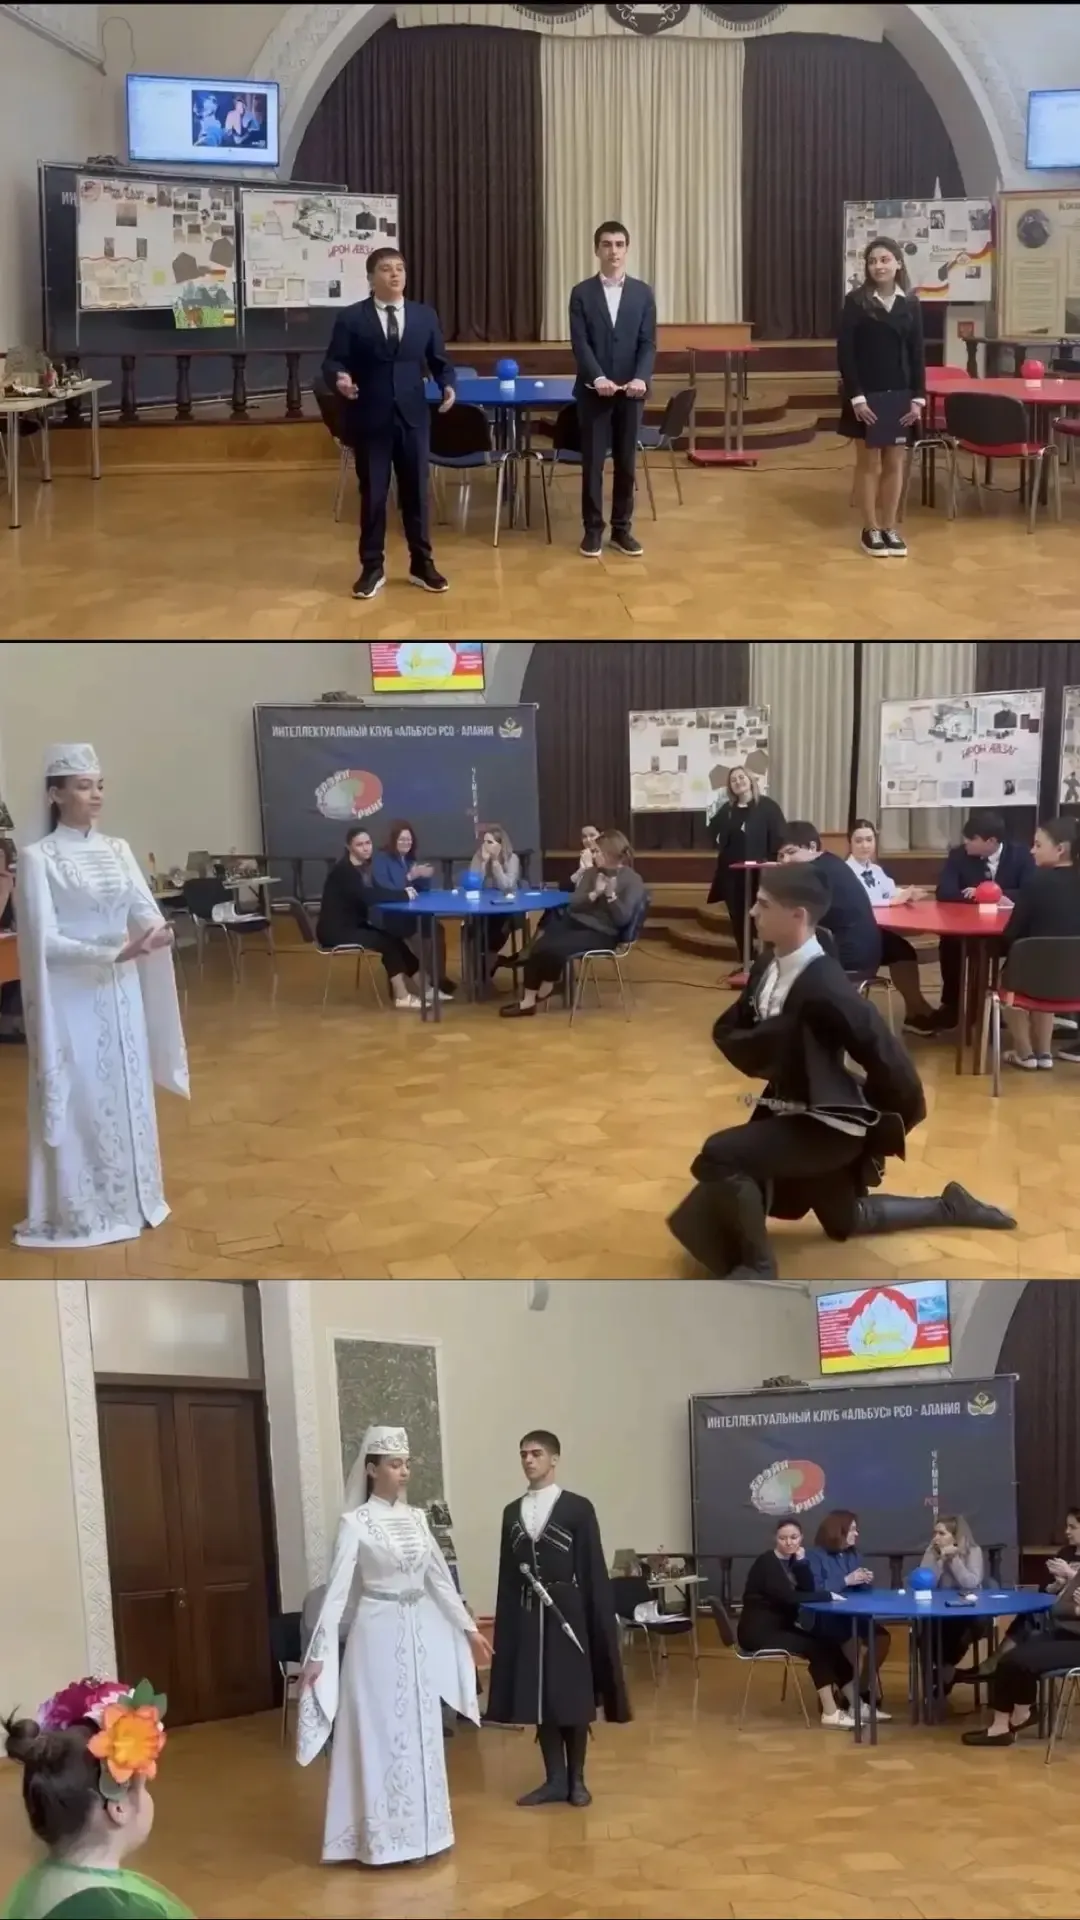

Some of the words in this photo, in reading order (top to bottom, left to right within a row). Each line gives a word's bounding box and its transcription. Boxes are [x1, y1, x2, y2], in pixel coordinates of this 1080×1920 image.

[272, 725, 368, 737] ИНТЕЛЛЕКТУАЛЬНЫЙ
[369, 725, 393, 737] КЛУБ
[438, 725, 455, 736] РСО
[461, 725, 494, 737] АЛАНИЯ
[707, 1409, 811, 1429] ИНТЕЛЛЕКТУАЛЬНЫЙ
[812, 1408, 840, 1423] КЛУБ
[841, 1405, 892, 1420] «АЛЬБУС»
[893, 1405, 912, 1418] РСО
[920, 1401, 961, 1416] АЛАНИЯ
